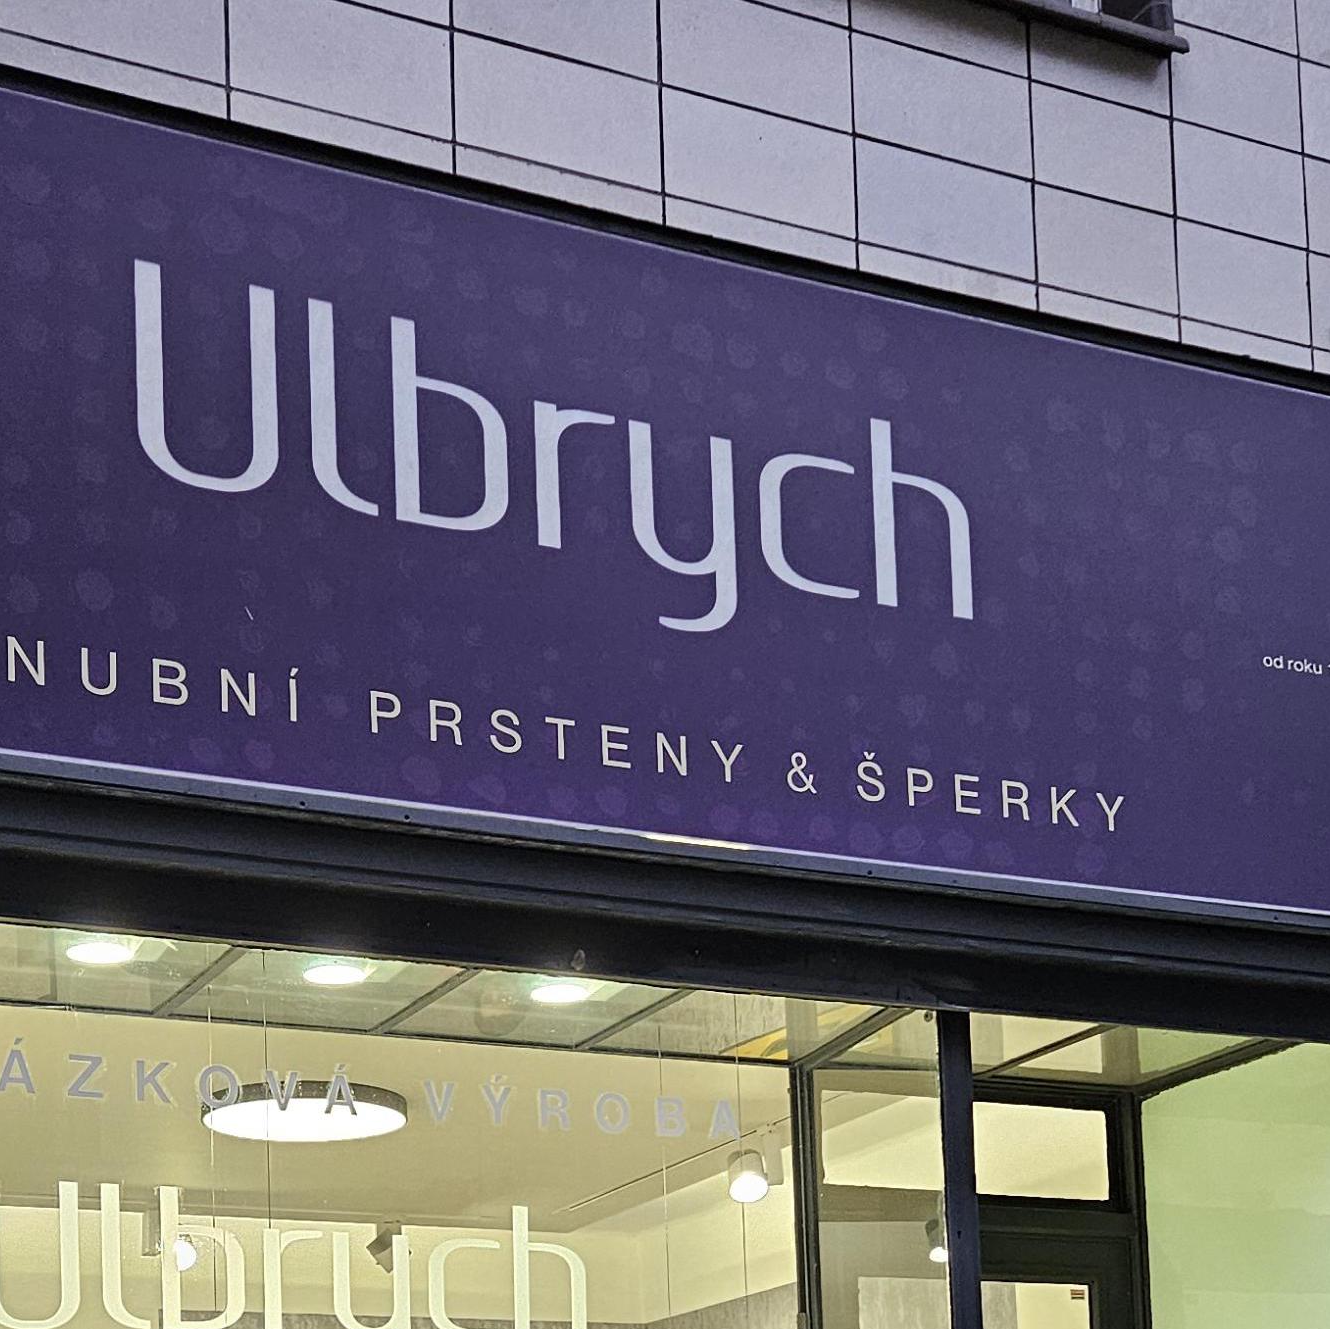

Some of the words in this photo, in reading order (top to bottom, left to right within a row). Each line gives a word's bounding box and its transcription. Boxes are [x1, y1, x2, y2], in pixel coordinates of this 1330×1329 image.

[132, 257, 975, 633] Ulbrych
[1262, 655, 1285, 669] od
[1287, 658, 1323, 675] roku
[369, 689, 744, 784] PRSTENY
[786, 751, 818, 795] &
[856, 750, 1125, 833] ŠPERKY
[422, 1072, 742, 1141] VÝROBA
